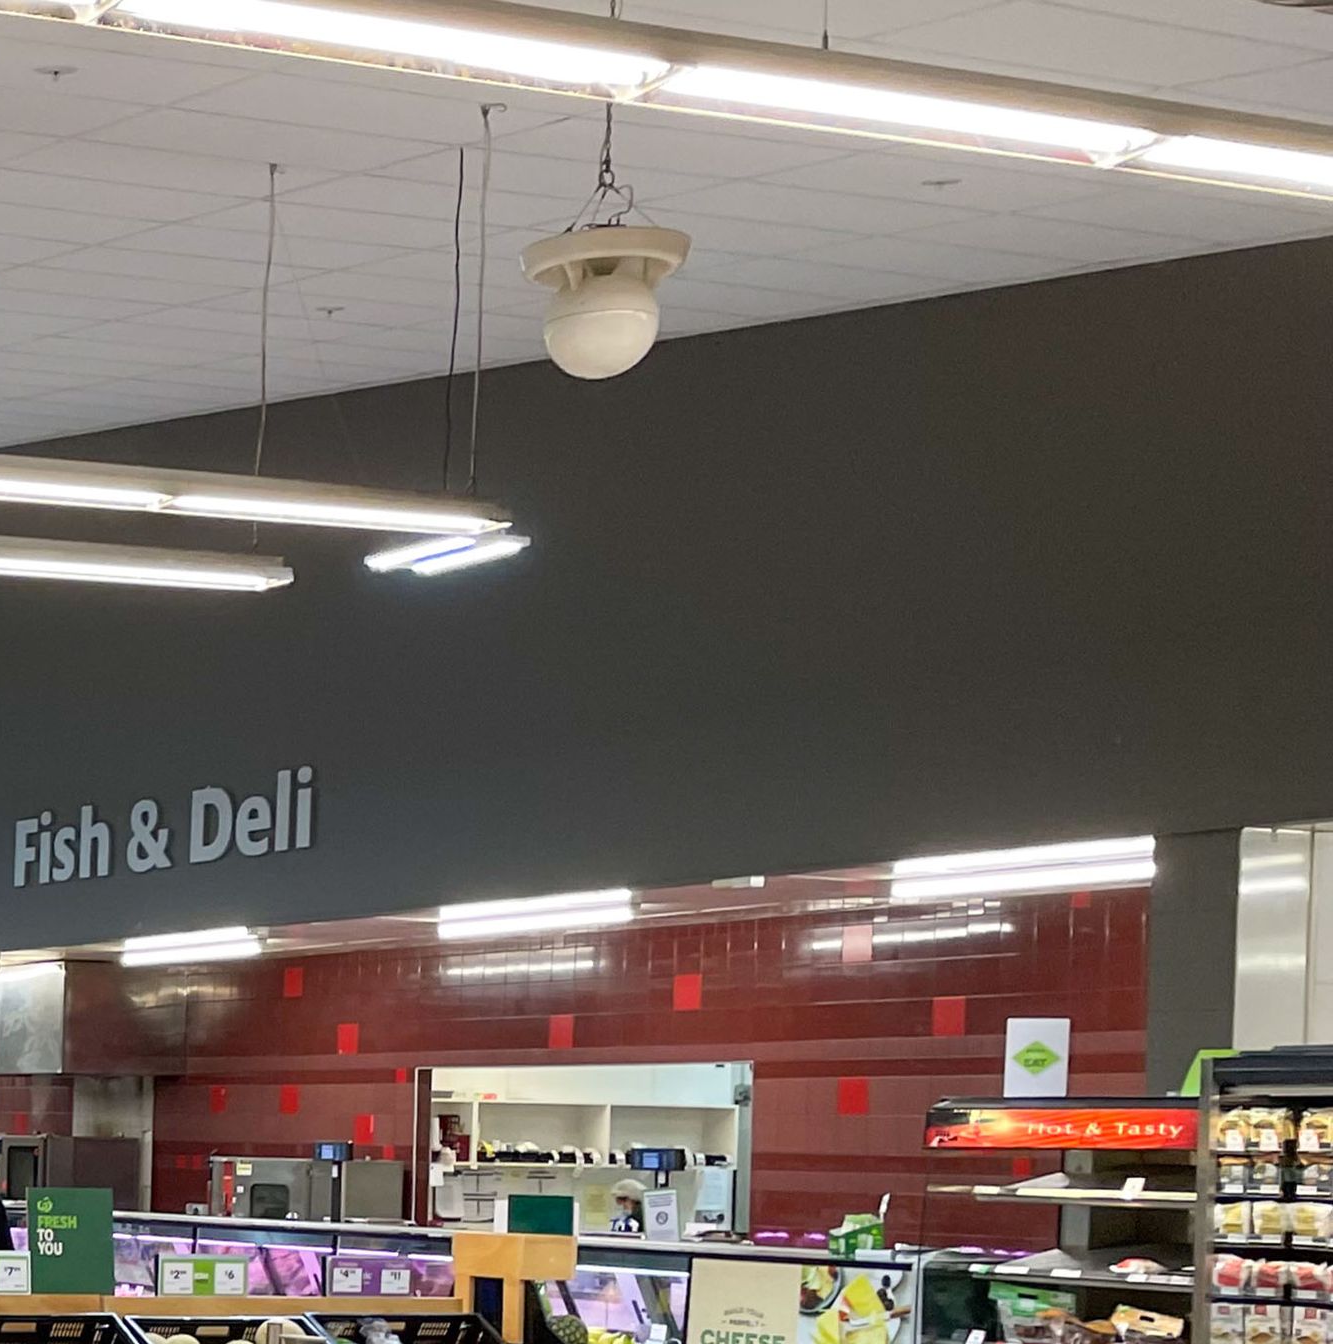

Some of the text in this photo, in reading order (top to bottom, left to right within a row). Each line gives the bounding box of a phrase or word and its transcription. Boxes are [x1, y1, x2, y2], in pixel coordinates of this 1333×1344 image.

[13, 765, 314, 888] Fish & Deli
[1027, 1122, 1184, 1138] Hot & Tasty
[37, 1215, 78, 1229] FRESH
[36, 1228, 54, 1242] TO
[36, 1242, 64, 1256] YOU
